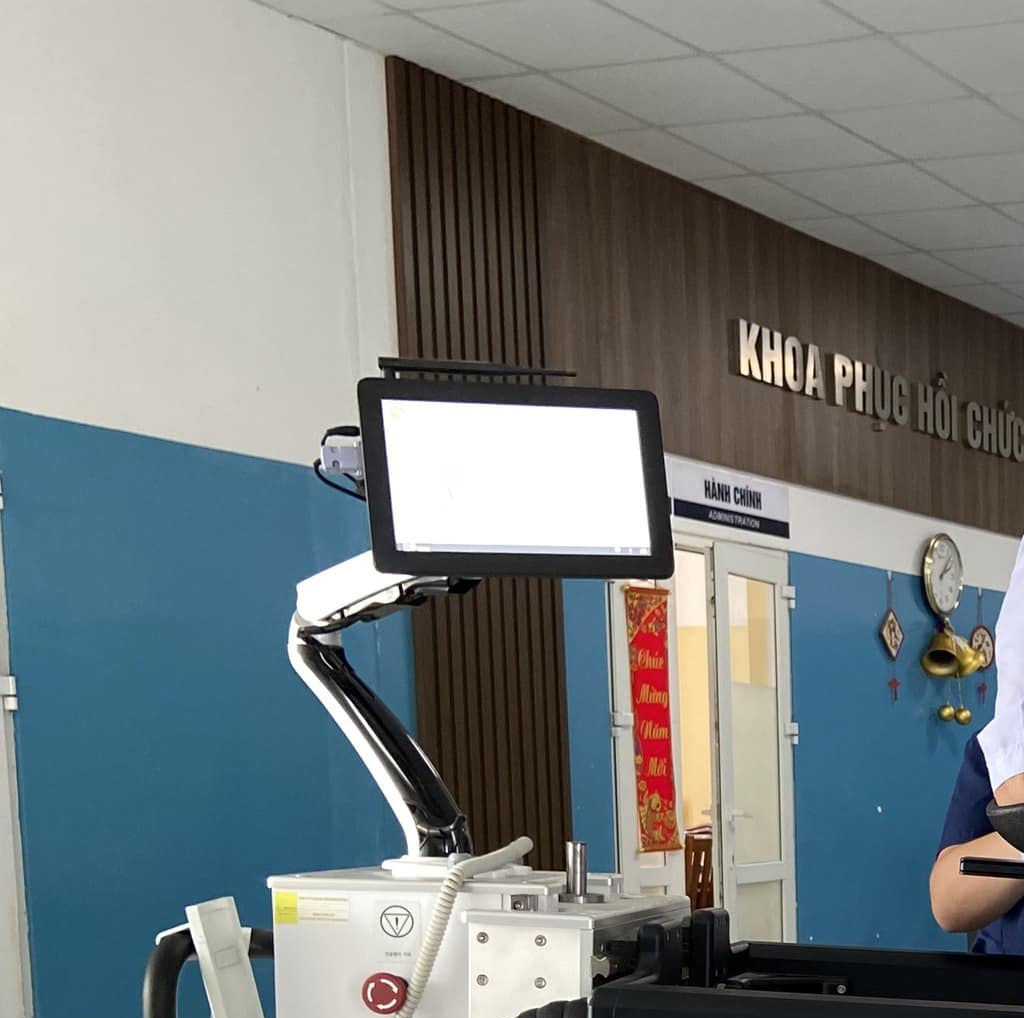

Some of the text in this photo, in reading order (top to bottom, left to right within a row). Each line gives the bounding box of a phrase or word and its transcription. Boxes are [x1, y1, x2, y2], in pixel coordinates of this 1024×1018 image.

[739, 318, 826, 401] KHOA
[834, 352, 909, 432] PHỤC
[917, 370, 960, 441] HỒI
[704, 477, 762, 511] HÀNH CHÍNH
[708, 510, 761, 529] ADMINISTRATION
[637, 648, 665, 670] Chúc
[640, 719, 669, 740] Năm
